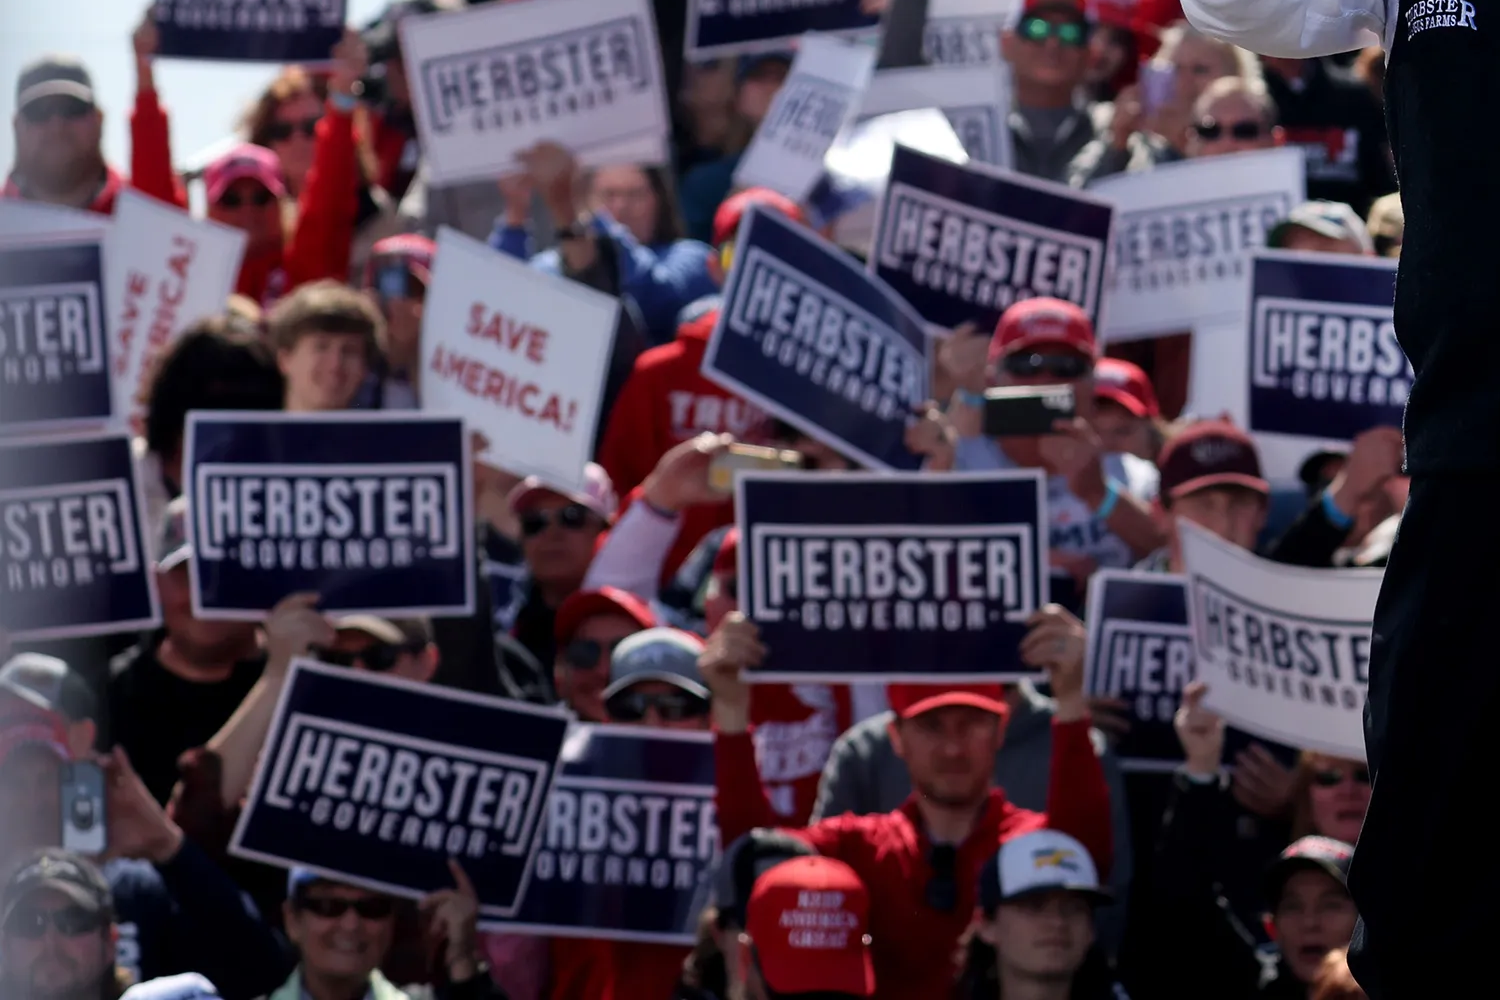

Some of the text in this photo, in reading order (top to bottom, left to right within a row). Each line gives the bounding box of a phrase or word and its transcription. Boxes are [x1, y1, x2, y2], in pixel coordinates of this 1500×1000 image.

[1425, 14, 1457, 30] FARMS
[439, 27, 638, 114] HERBSTER
[893, 201, 1087, 303] HERBSTER
[466, 302, 550, 365] SAVE
[746, 265, 925, 410] HERBSTER
[1268, 311, 1405, 378] HERBS
[431, 341, 577, 434] AMERICA!
[208, 477, 443, 545] HERBSTER
[238, 538, 413, 570] GOVERNOR
[767, 537, 1018, 607] HERBSTER
[801, 601, 988, 633] GOVERNOR
[1206, 593, 1369, 685] HERBSTE
[286, 729, 531, 842] HERBSTER
[310, 796, 486, 859] GOVERNOR
[536, 850, 695, 889] OVERNOR
